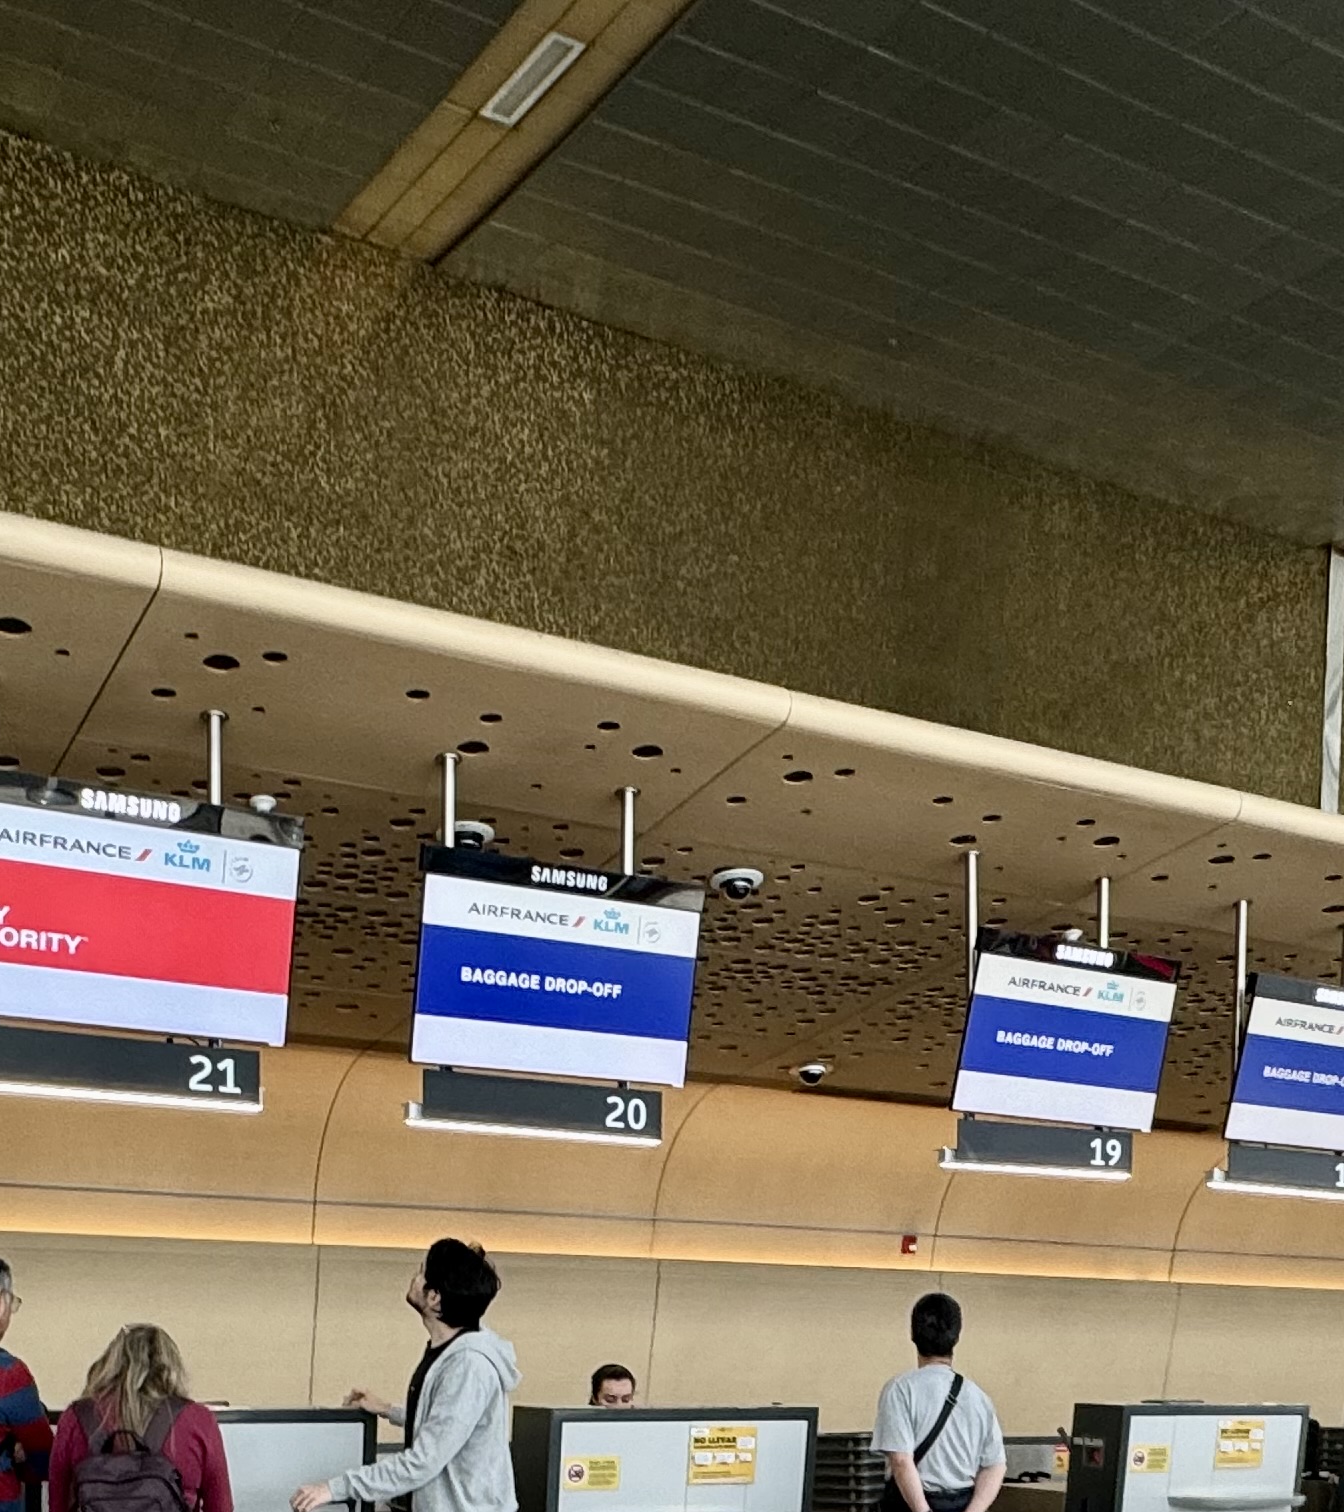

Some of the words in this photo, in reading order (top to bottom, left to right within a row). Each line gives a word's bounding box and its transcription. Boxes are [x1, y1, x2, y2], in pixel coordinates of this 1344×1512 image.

[80, 788, 181, 823] SAMSUNG
[163, 851, 211, 873] KLM
[530, 865, 608, 891] SAMSUNG
[467, 902, 570, 927] AIRFRANCE
[593, 918, 630, 936] KLM
[460, 966, 540, 991] BAGGAGE
[544, 976, 622, 999] DROP-OFF
[1007, 976, 1082, 997] AIRFRANCE
[1096, 988, 1125, 1004] KLM
[996, 1030, 1055, 1051] BAGGAGE
[1056, 1038, 1114, 1057] DROP-OFF
[188, 1054, 242, 1095] 21
[605, 1095, 648, 1130] 20
[1089, 1138, 1122, 1166] 19
